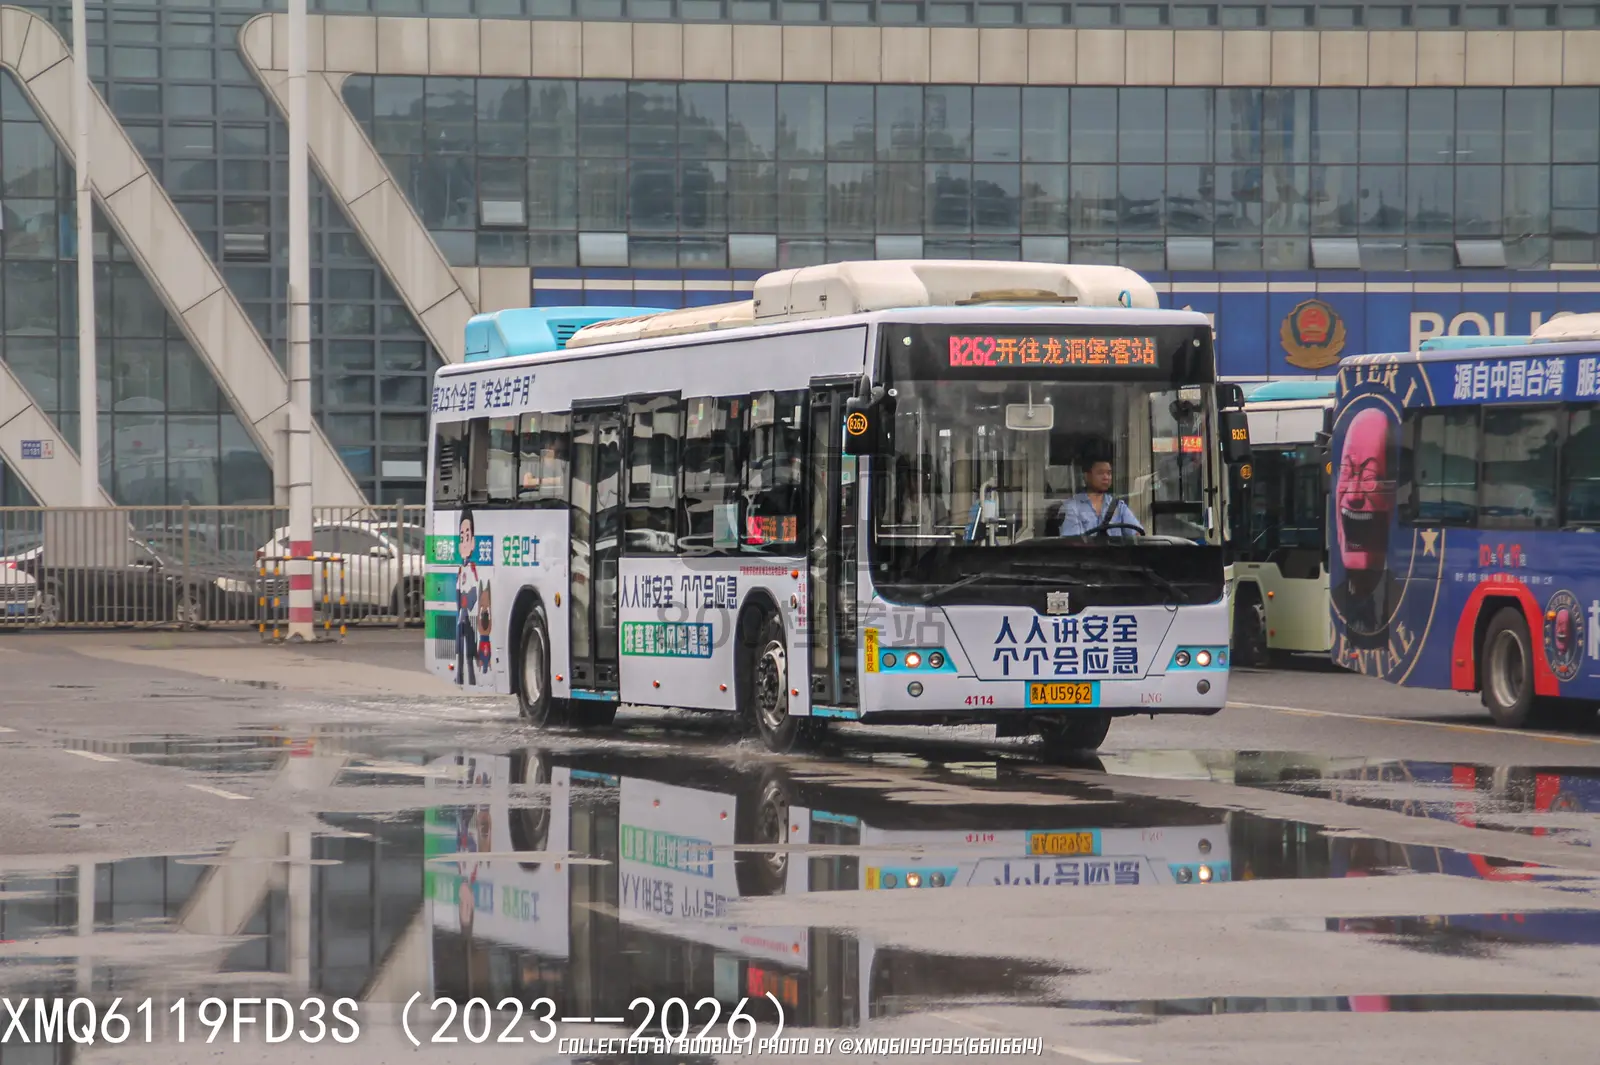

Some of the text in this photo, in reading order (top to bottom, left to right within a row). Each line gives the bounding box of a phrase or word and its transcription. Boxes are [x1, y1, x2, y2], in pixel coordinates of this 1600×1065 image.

[1453, 357, 1566, 400] 源自中国台湾
[1231, 427, 1247, 440] B262
[501, 535, 540, 567] 安全巴士
[621, 574, 738, 610] 人人讲安全 个个会应急
[994, 614, 1138, 645] 人人讲安全
[993, 646, 1139, 676] 个个会应急
[964, 695, 994, 706] 4114
[1140, 693, 1163, 703] LNG
